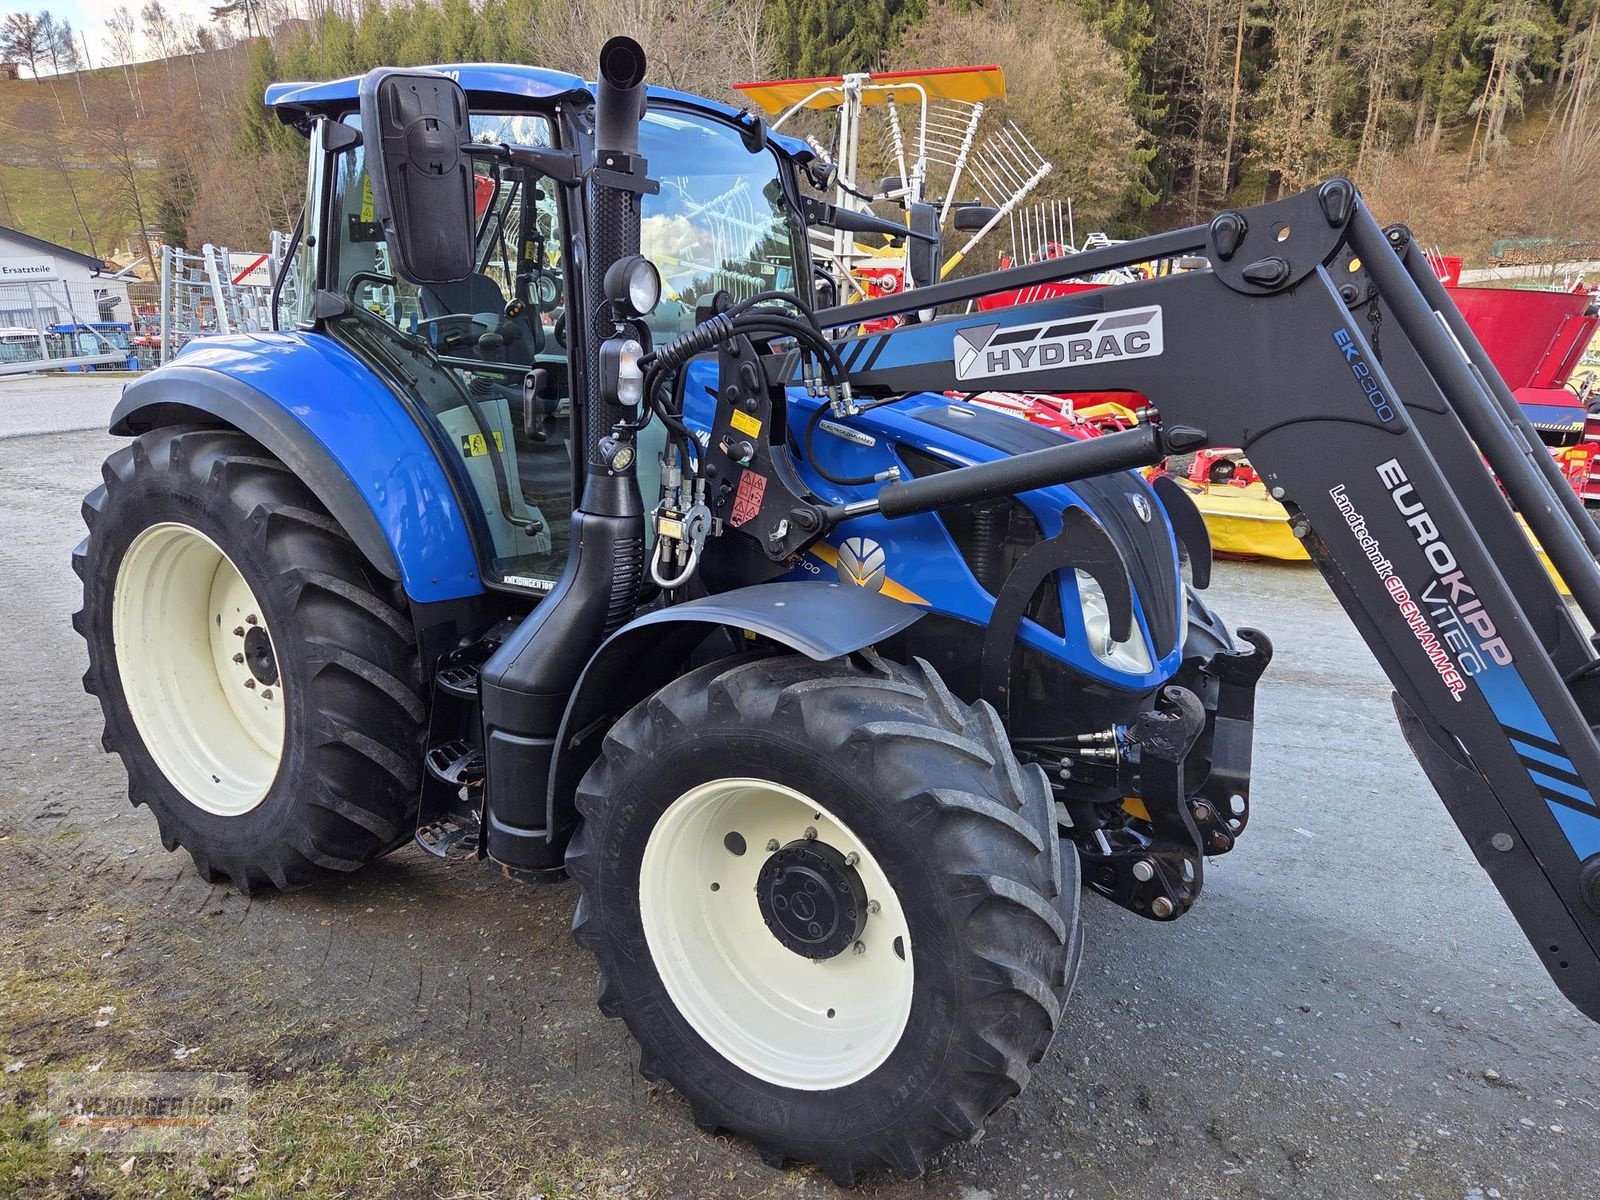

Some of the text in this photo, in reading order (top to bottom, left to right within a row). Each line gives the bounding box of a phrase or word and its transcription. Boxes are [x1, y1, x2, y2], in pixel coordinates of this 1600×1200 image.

[2, 265, 51, 275] Ersatzteile
[986, 330, 1151, 373] HYDRAC
[1333, 327, 1394, 423] EK 2300
[1329, 484, 1467, 702] Landtechnik EIDENHAMMER
[1375, 457, 1513, 666] EUROKIPP
